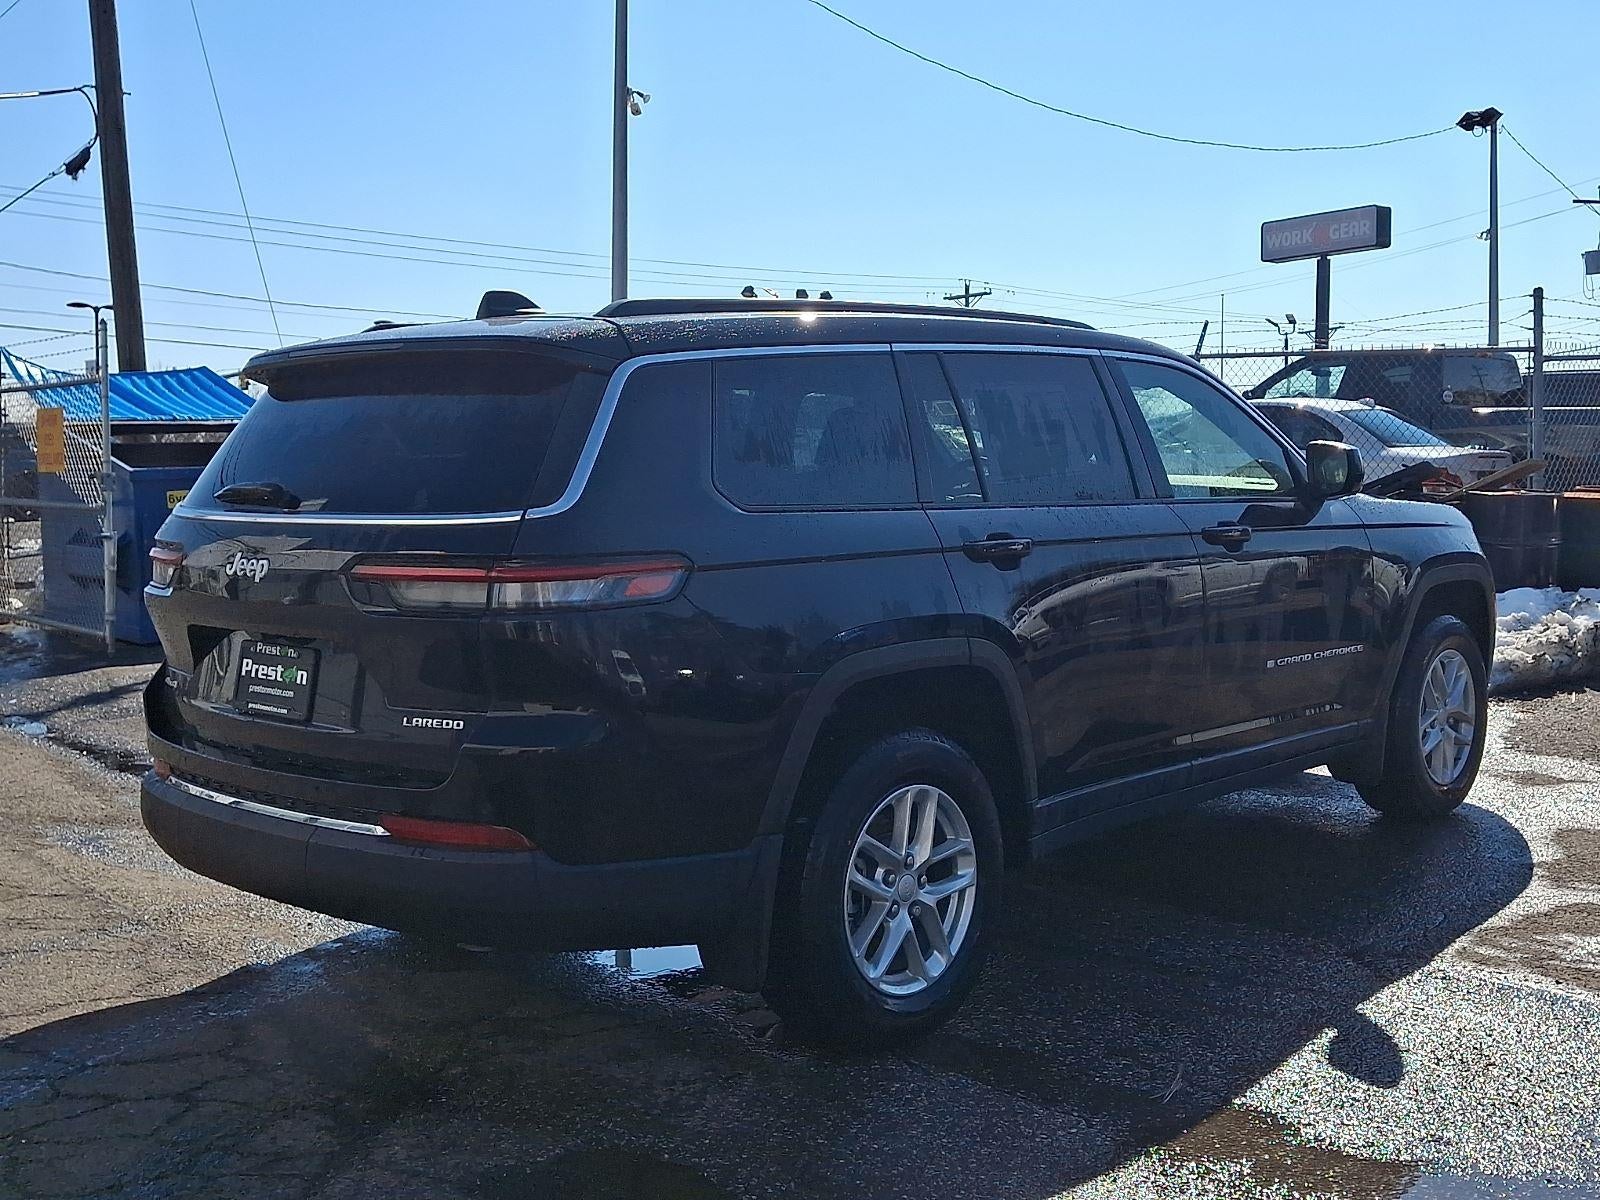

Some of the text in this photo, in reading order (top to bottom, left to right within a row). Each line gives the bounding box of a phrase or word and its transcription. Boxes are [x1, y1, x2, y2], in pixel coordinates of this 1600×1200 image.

[1265, 228, 1314, 249] WORK
[1329, 220, 1371, 240] GEAR
[225, 551, 269, 583] Jeep
[1277, 644, 1364, 666] GRAND CHEROKEE
[241, 657, 308, 685] Preston
[248, 684, 295, 698] prestonmotor.com
[402, 716, 464, 730] LAREDO
